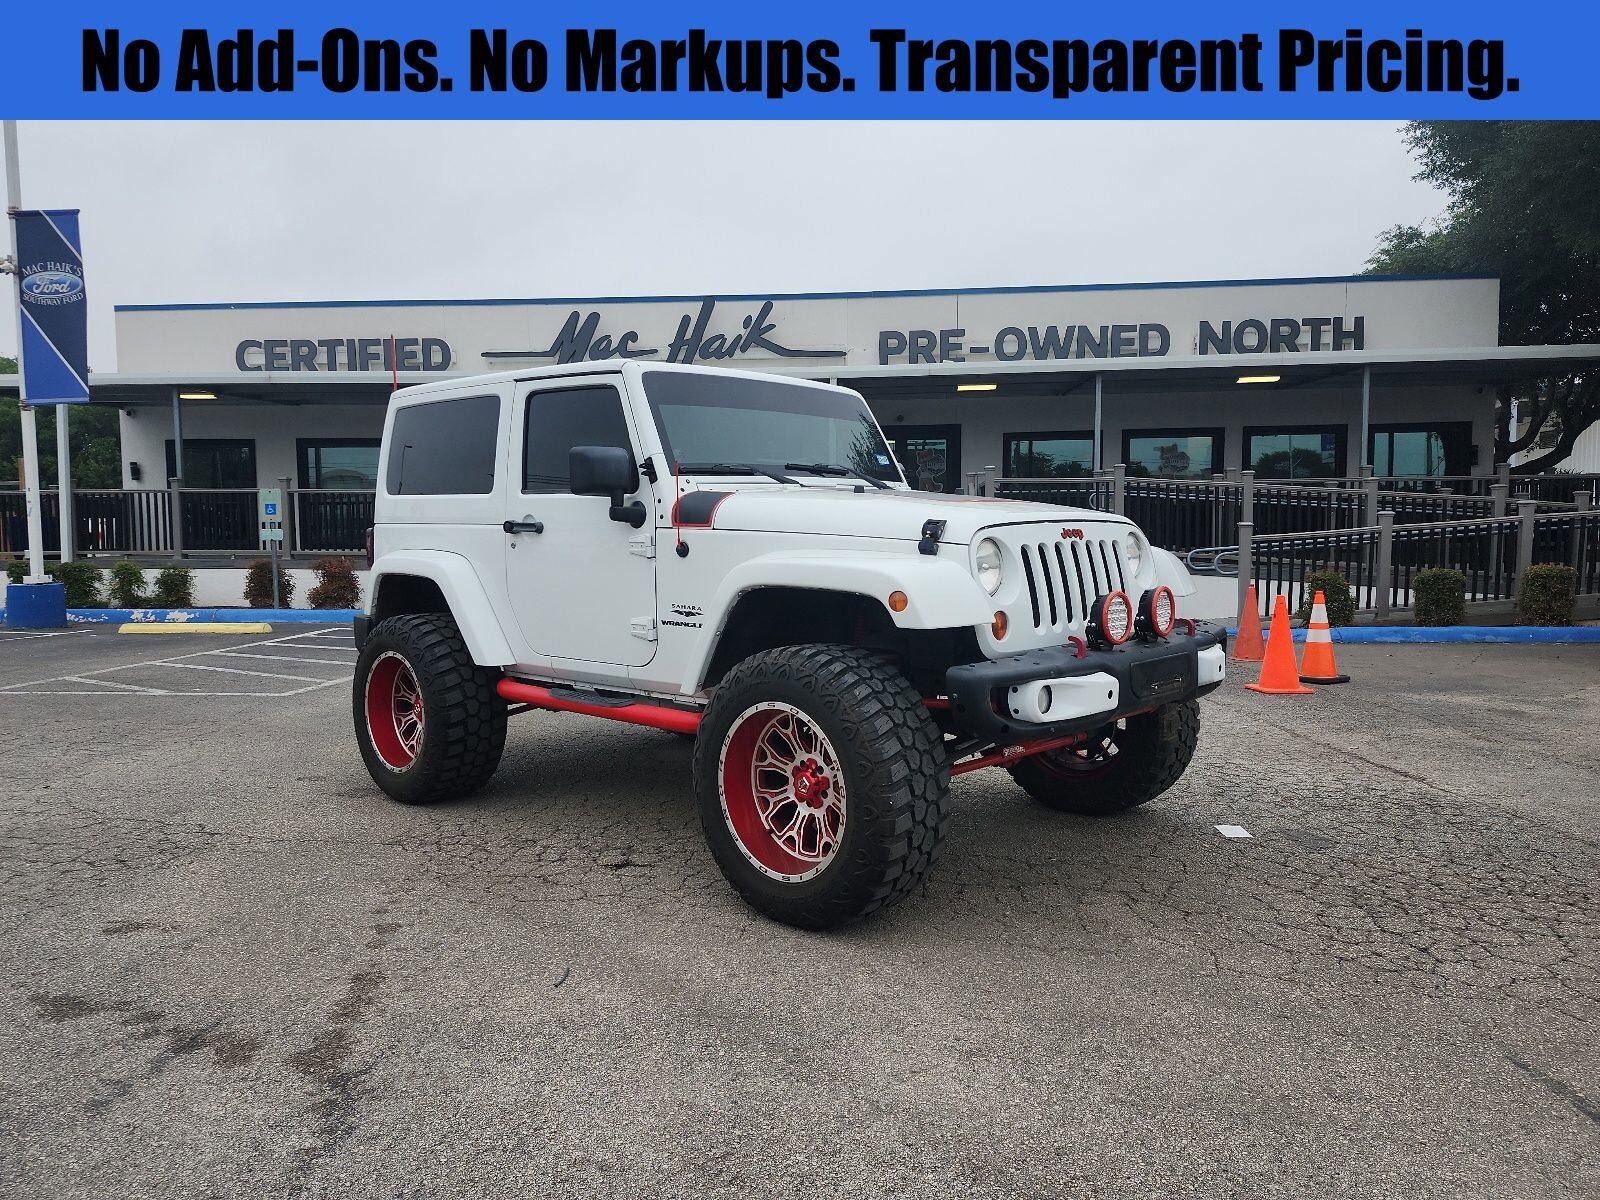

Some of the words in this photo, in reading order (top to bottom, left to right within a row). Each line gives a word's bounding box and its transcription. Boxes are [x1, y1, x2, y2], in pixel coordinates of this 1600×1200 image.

[22, 262, 44, 277] MAC
[47, 261, 83, 277] HAIK'S
[32, 276, 71, 294] Ford
[23, 293, 62, 306] SOUTHWAY
[63, 292, 84, 305] FORD
[481, 310, 659, 364] Mac
[667, 297, 847, 364] Haik
[878, 323, 1171, 366] PRE-OWNED
[1198, 315, 1366, 356] NORTH
[235, 338, 452, 373] CERTIFIED
[1060, 527, 1085, 541] Jeep
[671, 603, 703, 612] SAHARA
